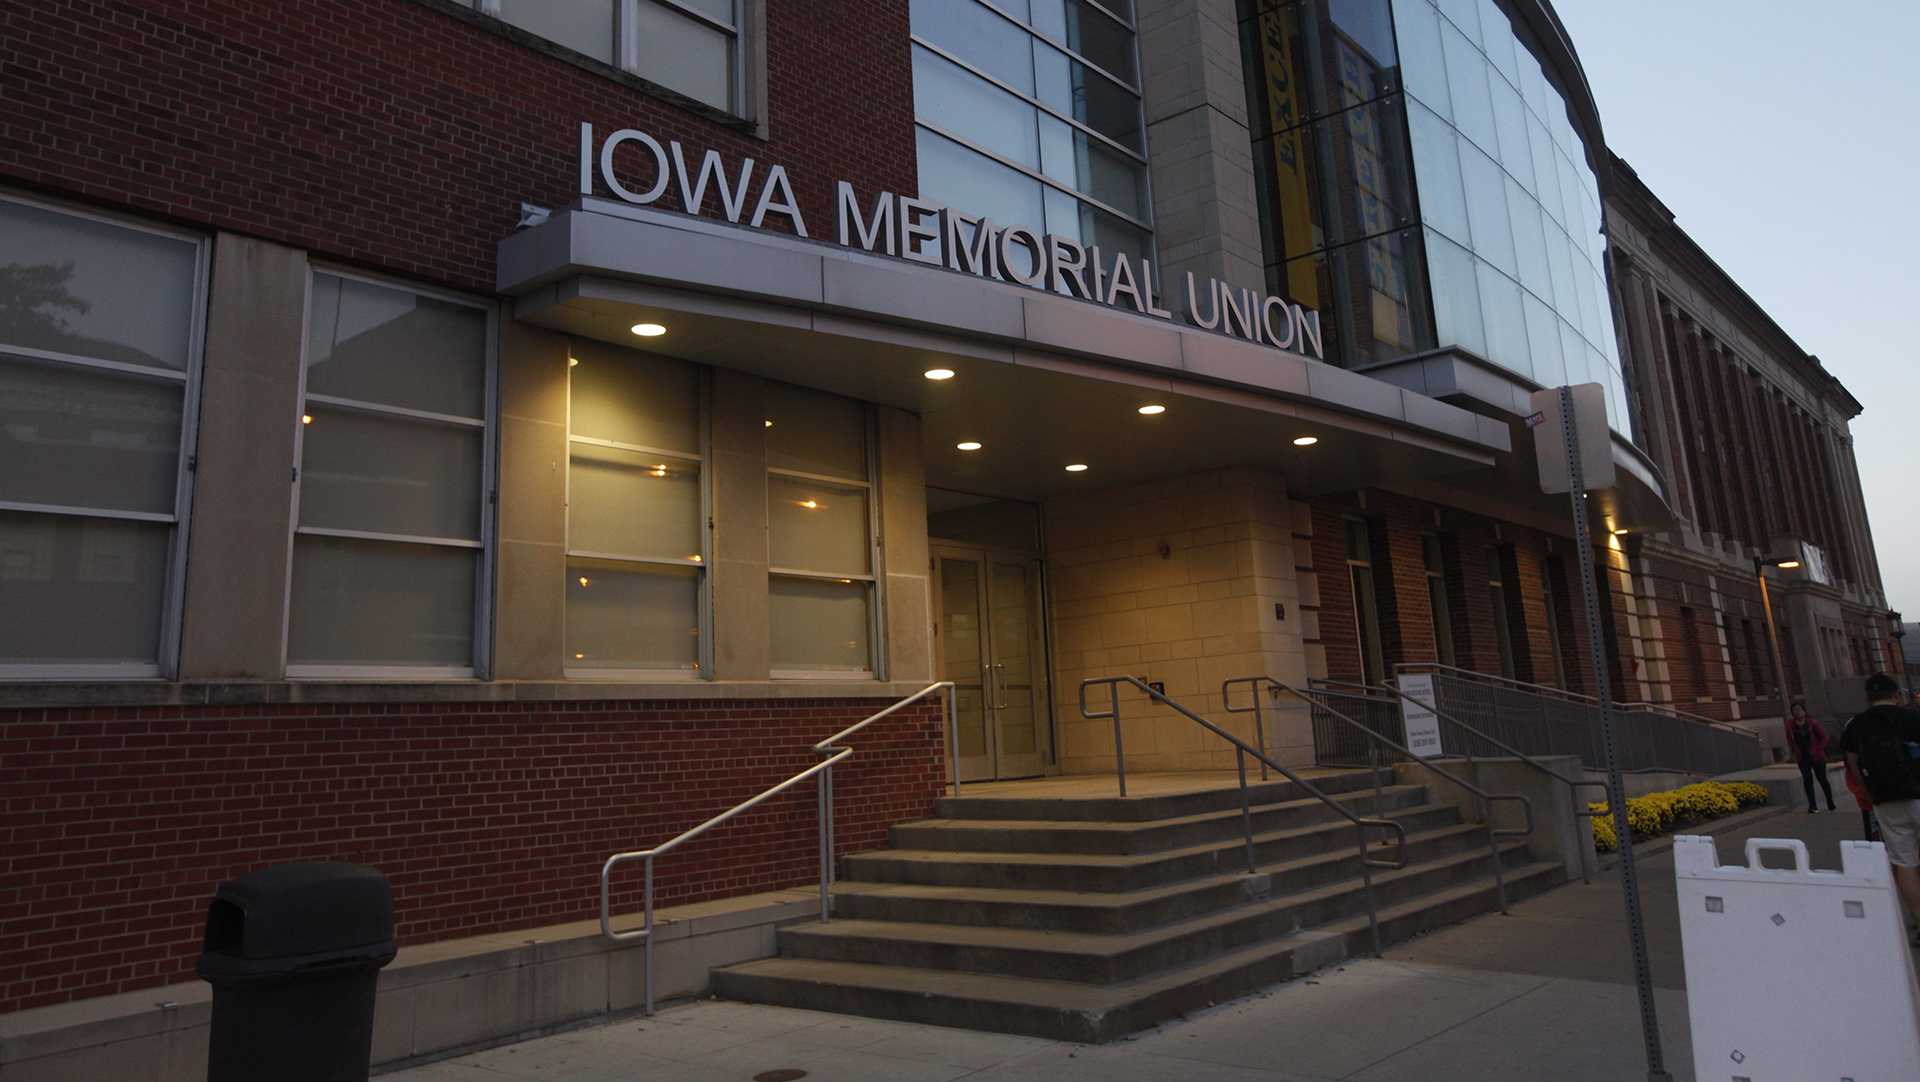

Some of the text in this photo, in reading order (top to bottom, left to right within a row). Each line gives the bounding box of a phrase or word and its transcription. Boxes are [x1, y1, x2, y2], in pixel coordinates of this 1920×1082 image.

[579, 121, 1323, 360] IOWA MEMORIAL UNION
